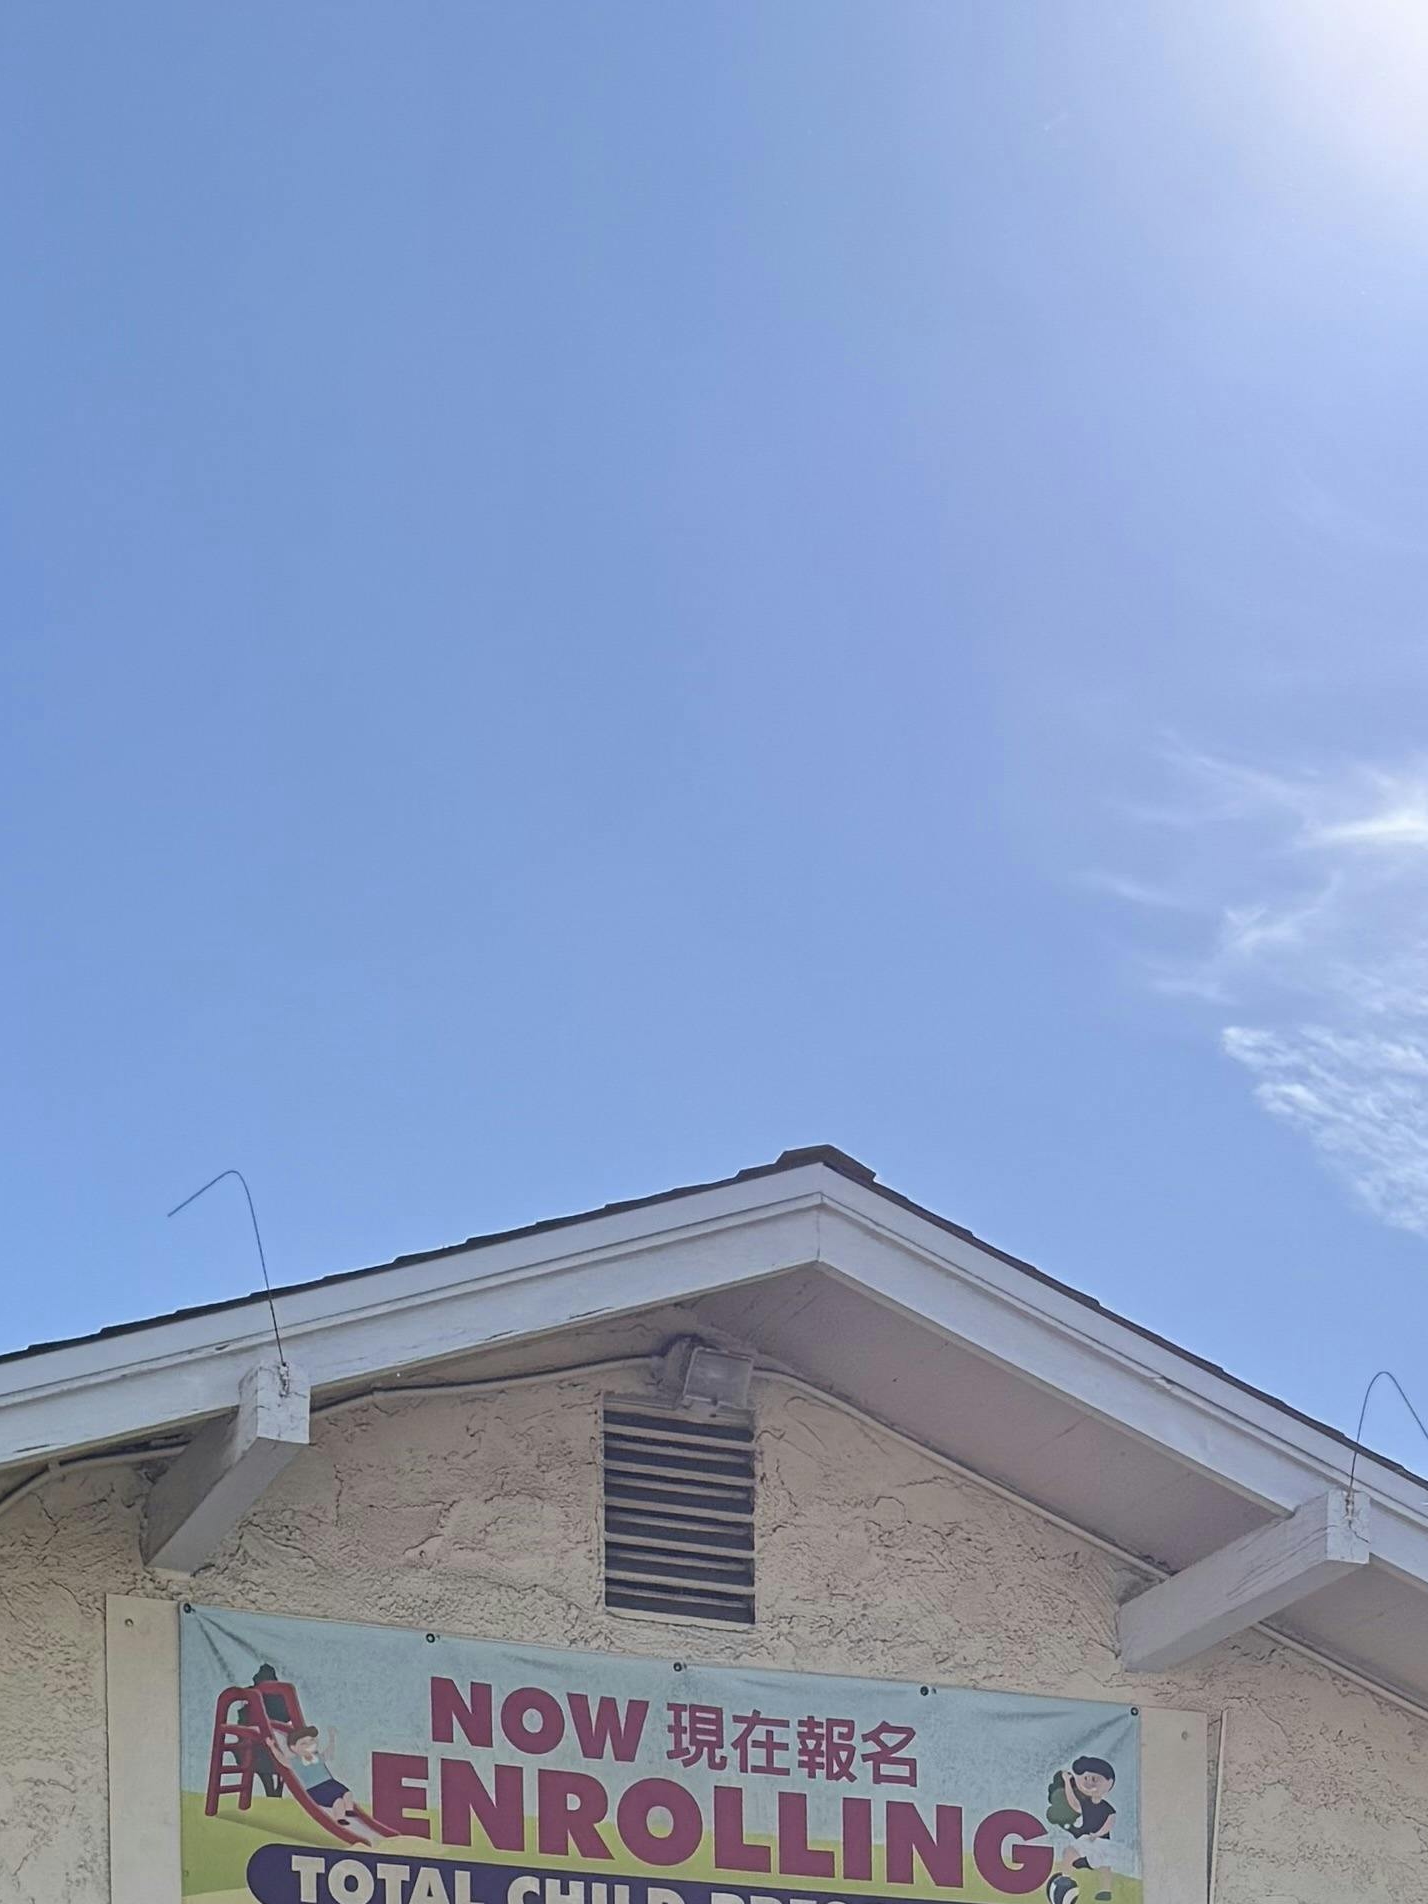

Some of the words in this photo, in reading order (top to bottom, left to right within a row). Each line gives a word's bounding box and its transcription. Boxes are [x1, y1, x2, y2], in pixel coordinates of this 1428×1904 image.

[430, 1676, 650, 1762] NOW
[665, 1702, 918, 1788] 現在報名
[371, 1751, 1055, 1894] ENROLLING
